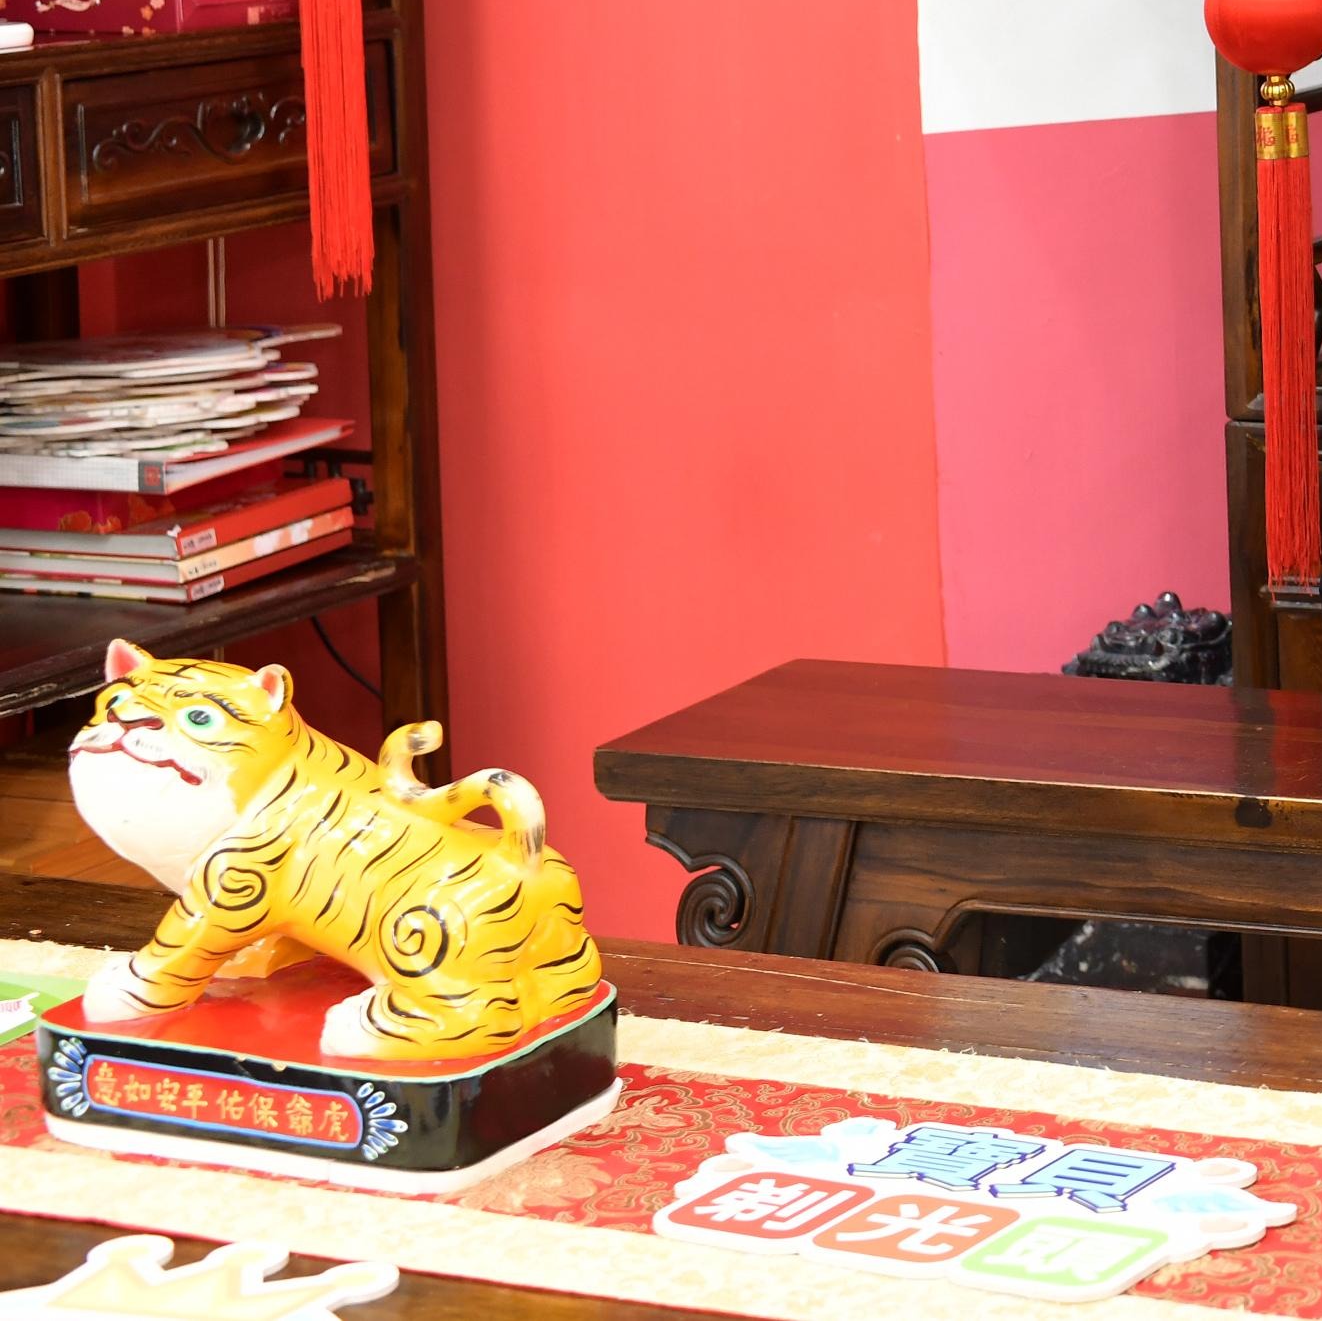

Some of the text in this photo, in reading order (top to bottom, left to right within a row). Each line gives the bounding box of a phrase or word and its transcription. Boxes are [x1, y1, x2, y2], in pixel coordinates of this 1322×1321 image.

[846, 1125, 1177, 1215] 寶貝
[693, 1178, 1154, 1282] 剃光頭
